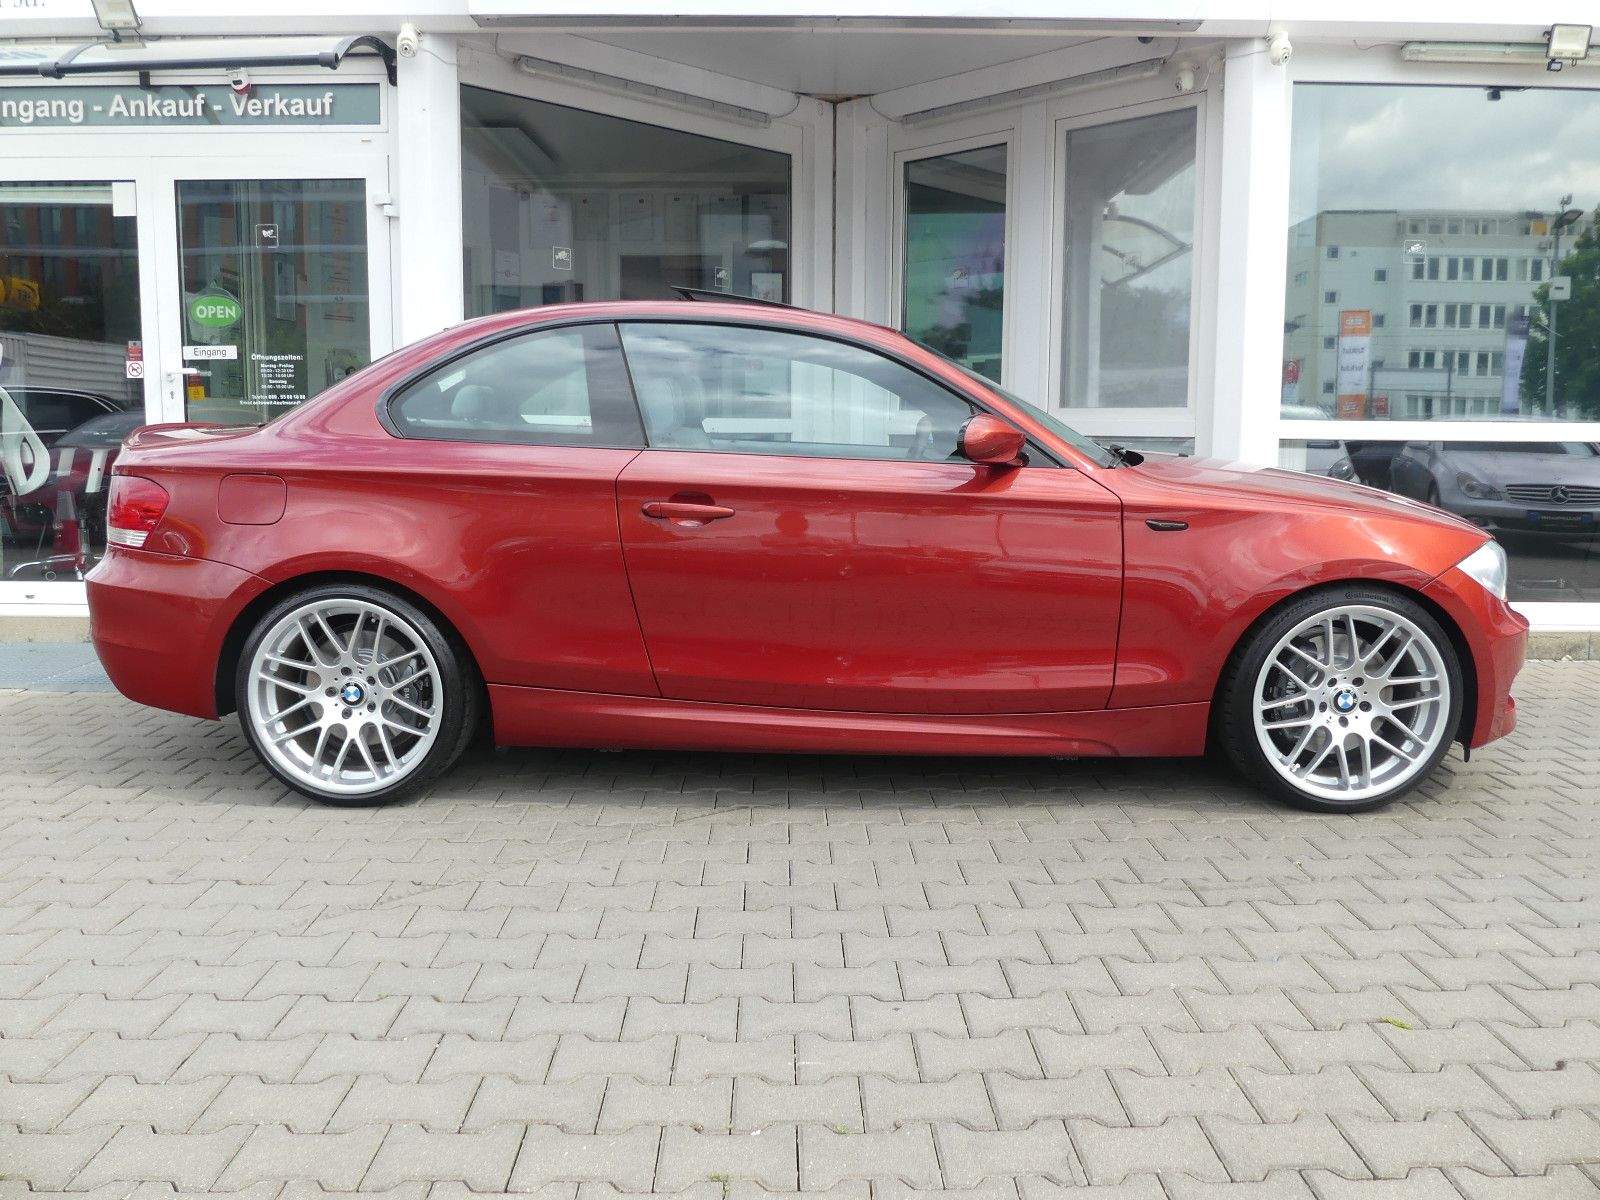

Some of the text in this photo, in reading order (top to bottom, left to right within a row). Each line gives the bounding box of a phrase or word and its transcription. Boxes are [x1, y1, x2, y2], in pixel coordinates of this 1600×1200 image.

[1, 99, 84, 124] ngang
[108, 93, 206, 118] Ankauf
[229, 92, 334, 118] Verkauf
[196, 305, 236, 319] OPEN
[193, 347, 227, 358] Eingang
